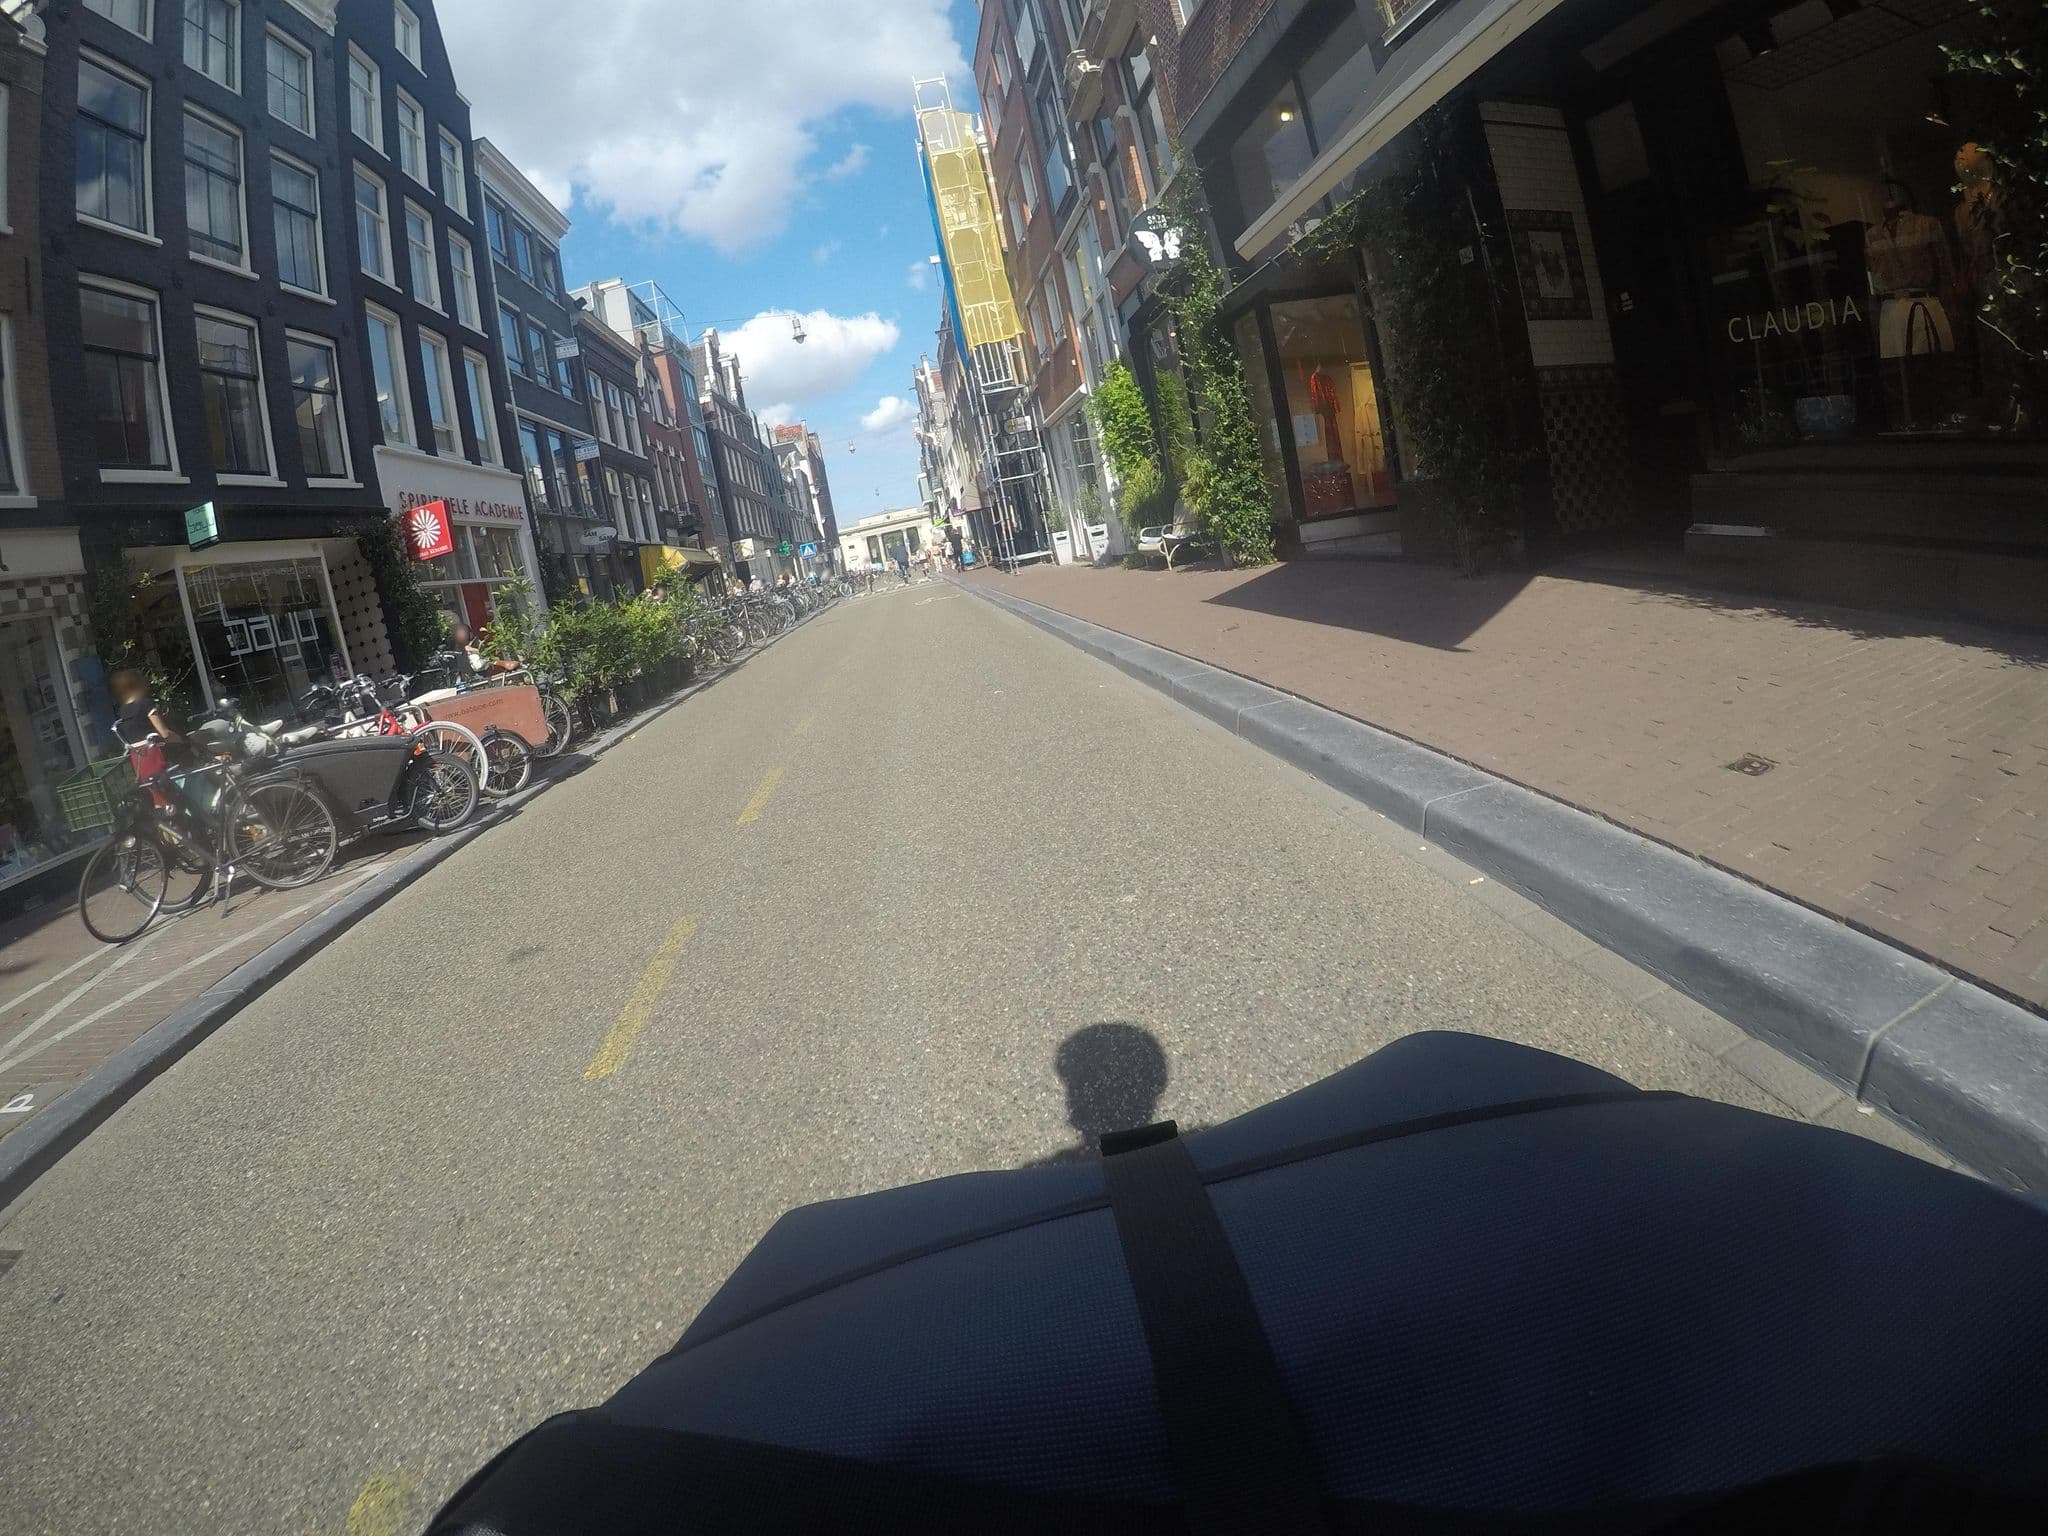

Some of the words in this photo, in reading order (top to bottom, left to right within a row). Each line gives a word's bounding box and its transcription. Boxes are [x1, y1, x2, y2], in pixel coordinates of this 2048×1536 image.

[1728, 295, 1863, 343] CLAUDIA
[399, 491, 470, 515] SPIRITELE
[475, 500, 524, 520] ACADEMIE
